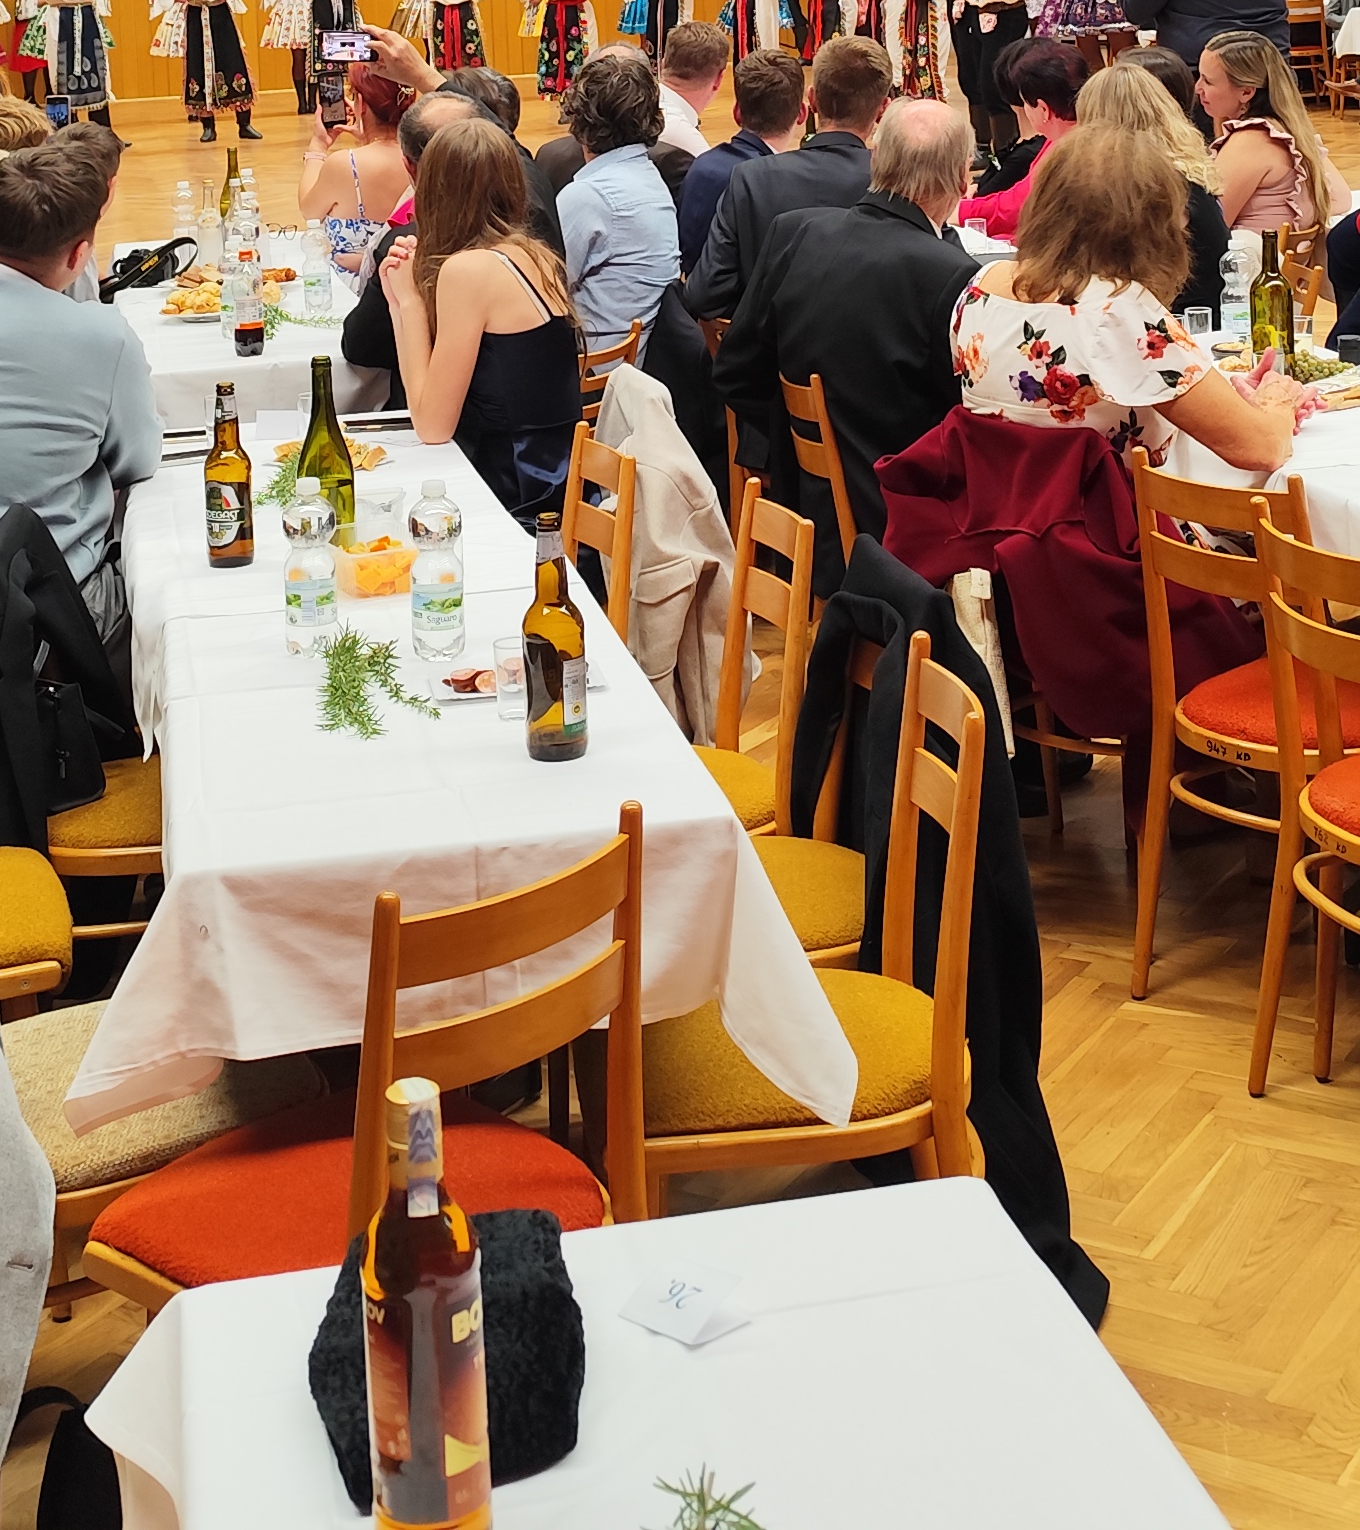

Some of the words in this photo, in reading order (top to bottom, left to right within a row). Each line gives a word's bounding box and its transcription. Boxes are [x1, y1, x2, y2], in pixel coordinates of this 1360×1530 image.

[206, 509, 240, 521] DEGAST
[426, 614, 458, 626] Saguaro
[1206, 739, 1227, 757] 947
[1236, 750, 1251, 761] KD
